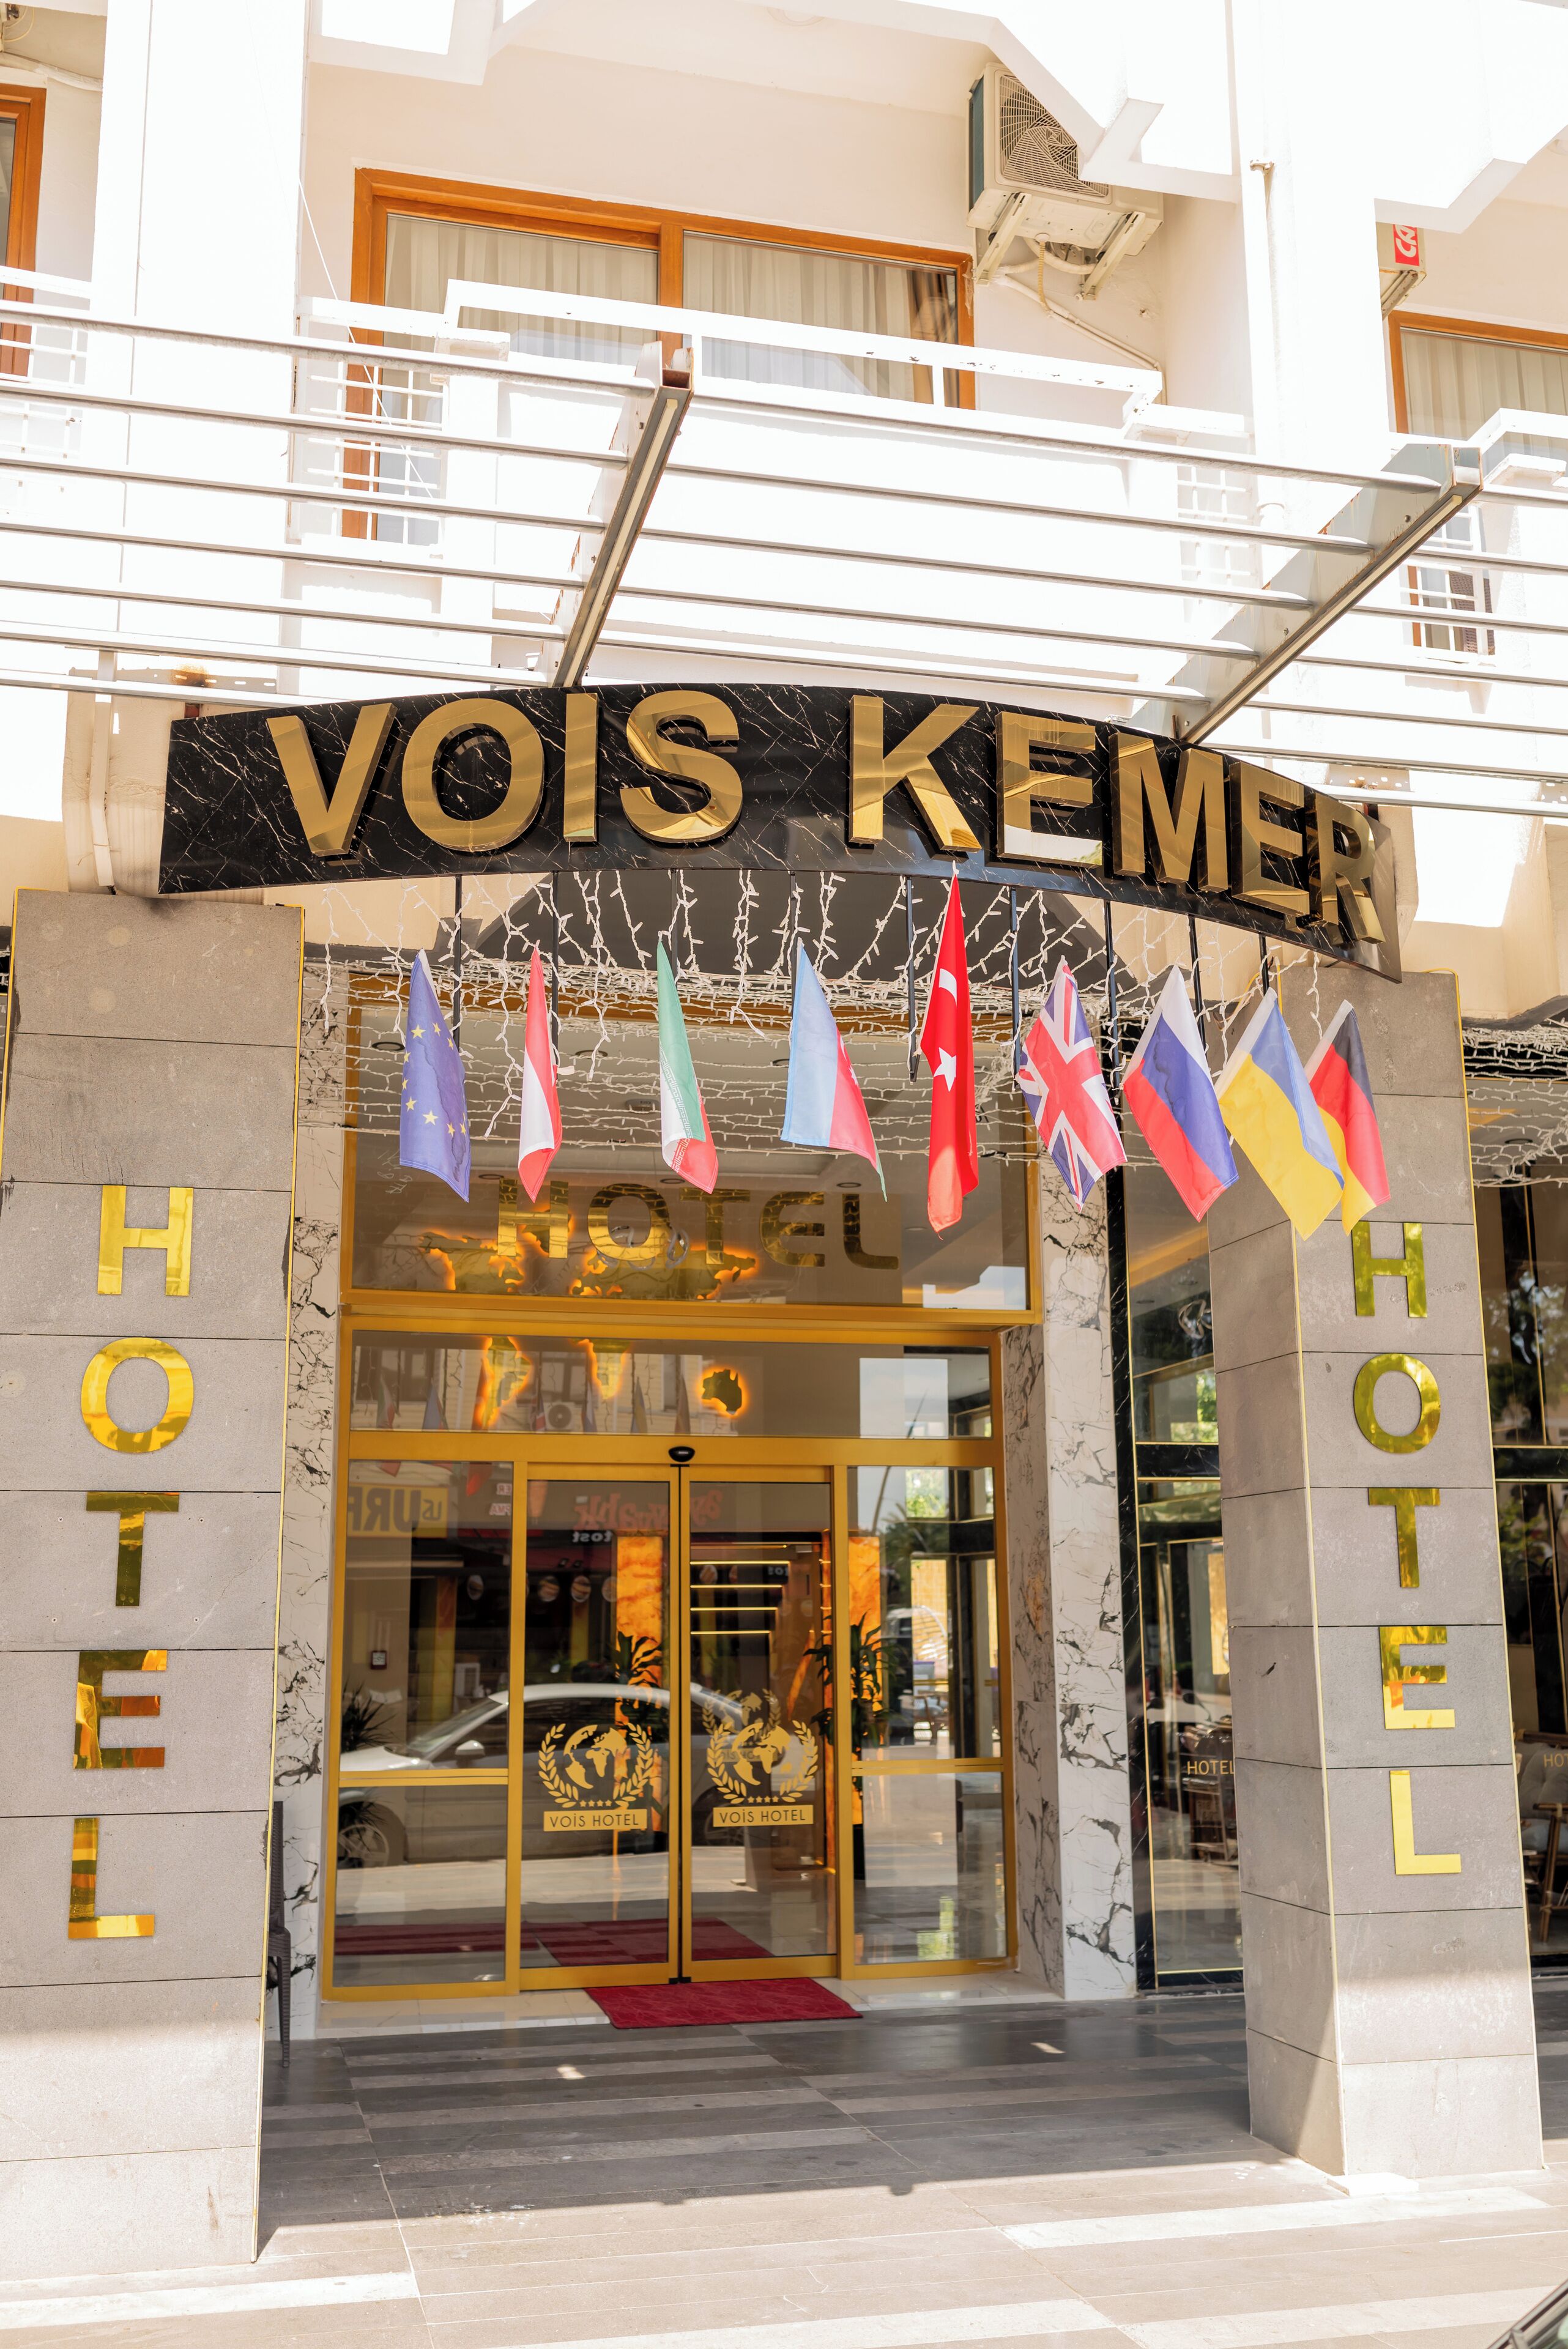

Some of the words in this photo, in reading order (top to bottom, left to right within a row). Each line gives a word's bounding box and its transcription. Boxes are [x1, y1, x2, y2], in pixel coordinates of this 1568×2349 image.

[267, 690, 743, 857] VOIS
[849, 695, 1386, 944] KEMER
[497, 1177, 899, 1270] HOTEL
[67, 1184, 195, 1939] HOTEL
[1351, 1220, 1462, 1875] HOTEL
[592, 1814, 639, 1827] HOTEL
[760, 1809, 806, 1822] HOTEL
